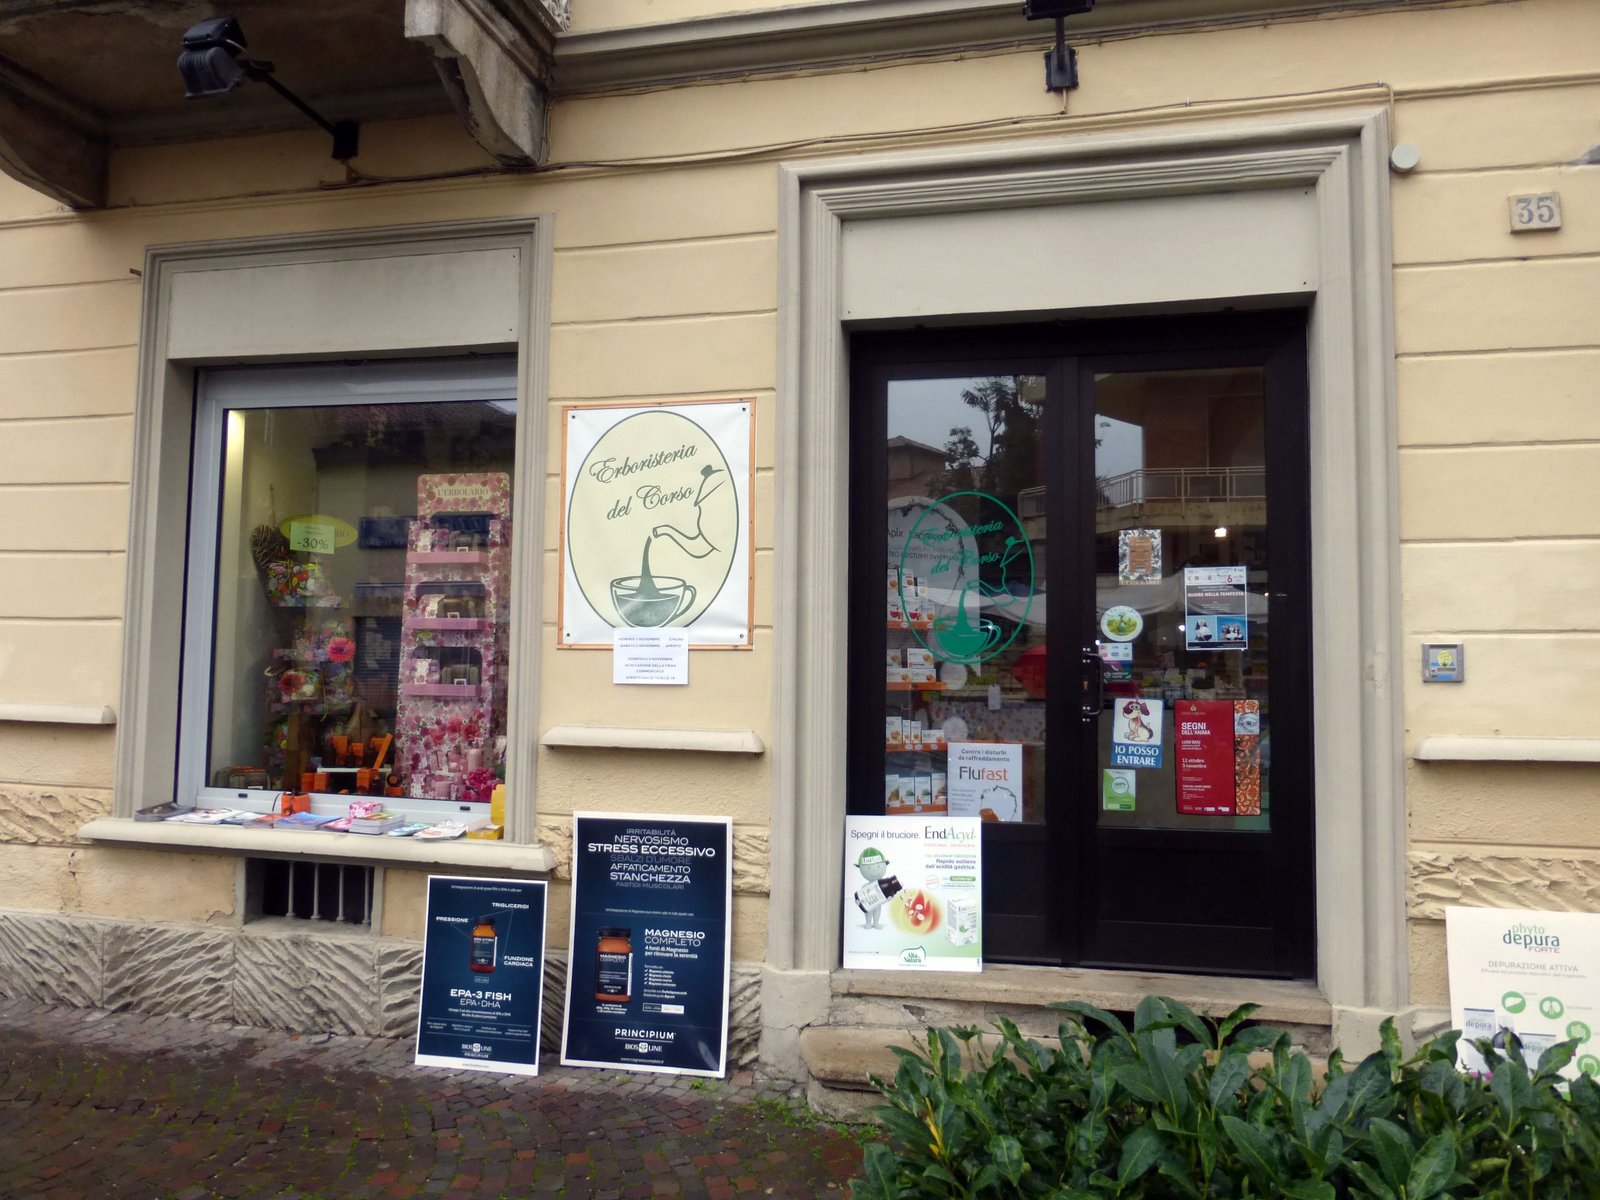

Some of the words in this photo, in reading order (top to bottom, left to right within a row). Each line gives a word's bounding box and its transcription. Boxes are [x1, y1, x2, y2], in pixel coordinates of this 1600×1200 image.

[1516, 195, 1555, 224] 35
[589, 443, 697, 483] Erboristeria
[607, 496, 632, 520] del
[636, 485, 694, 510] Corso
[297, 537, 329, 550] -30%
[1181, 722, 1206, 730] SEGNI
[1115, 745, 1126, 754] IO
[1128, 746, 1159, 756] POSSO
[1117, 755, 1156, 765] ENTRARE
[959, 766, 1008, 781] Flufast
[614, 835, 689, 846] NERVOSISMO
[851, 829, 879, 840] Spegni
[881, 829, 885, 838] il
[588, 843, 638, 854] STRESS
[641, 845, 716, 857] ECCESSIVO
[610, 854, 644, 862] SBALZI
[610, 863, 691, 874] AFFATICAMENTO
[609, 872, 691, 884] STANCHEZZA
[644, 928, 706, 939] MAGNESIO
[1512, 922, 1545, 936] phyto
[644, 937, 701, 947] COMPLETO
[1502, 930, 1560, 949] depura
[1488, 960, 1547, 970] DEPURAZIONE
[1549, 964, 1579, 973] ATTIVA
[450, 988, 483, 999] EPA-3
[485, 991, 512, 1001] FISH
[615, 1028, 675, 1040] PRINCIPIUM
